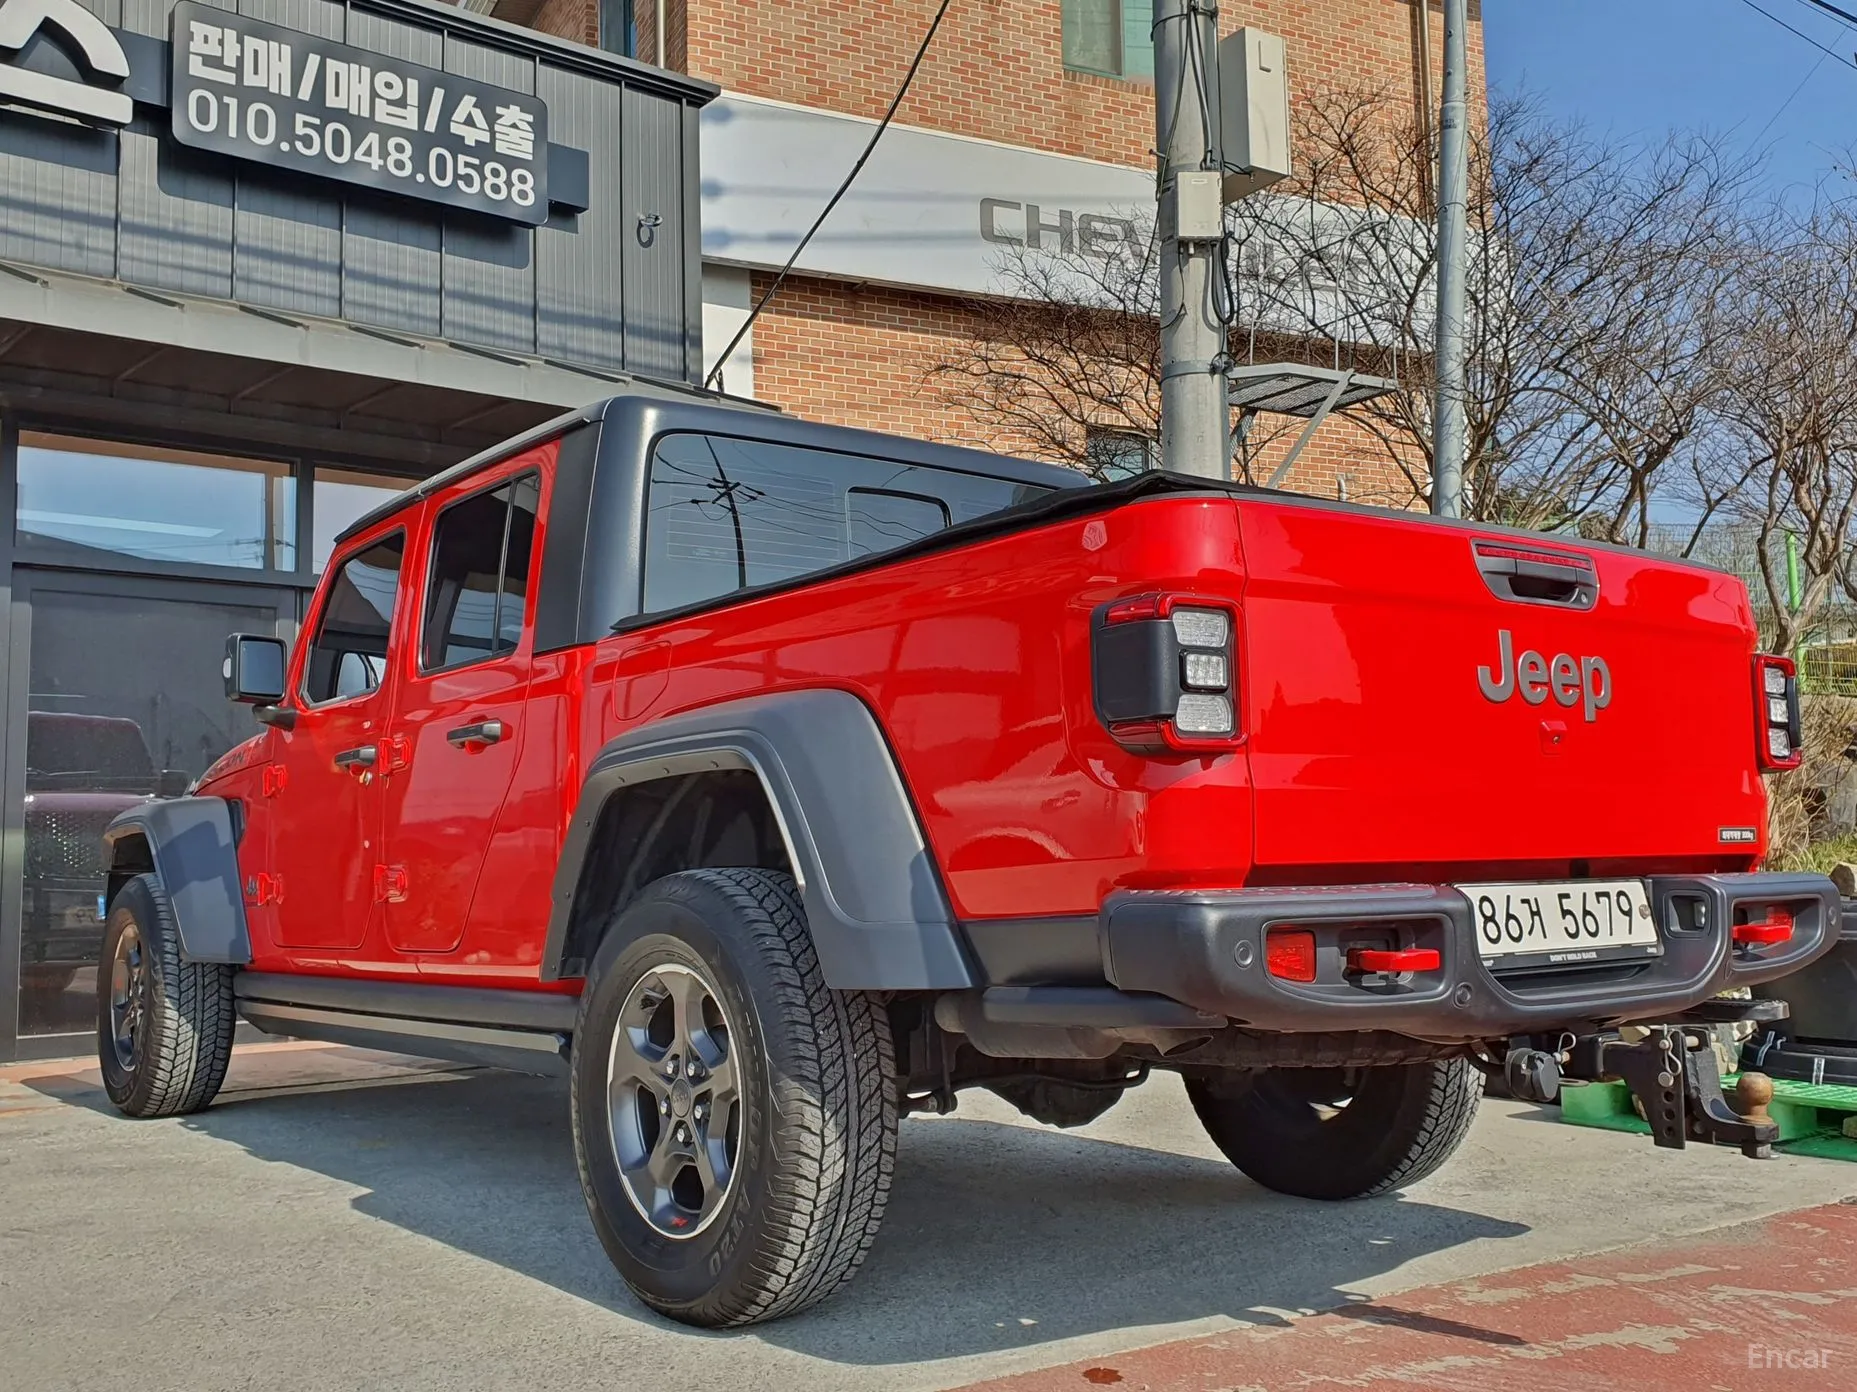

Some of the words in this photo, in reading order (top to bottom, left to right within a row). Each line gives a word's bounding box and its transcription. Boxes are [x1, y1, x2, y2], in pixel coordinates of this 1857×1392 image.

[189, 20, 534, 161] 판매/매입/수출
[188, 88, 536, 207] 010.5048.0588
[1477, 629, 1612, 722] Jeep
[1479, 895, 1547, 945] 86거
[1557, 889, 1633, 940] 5679
